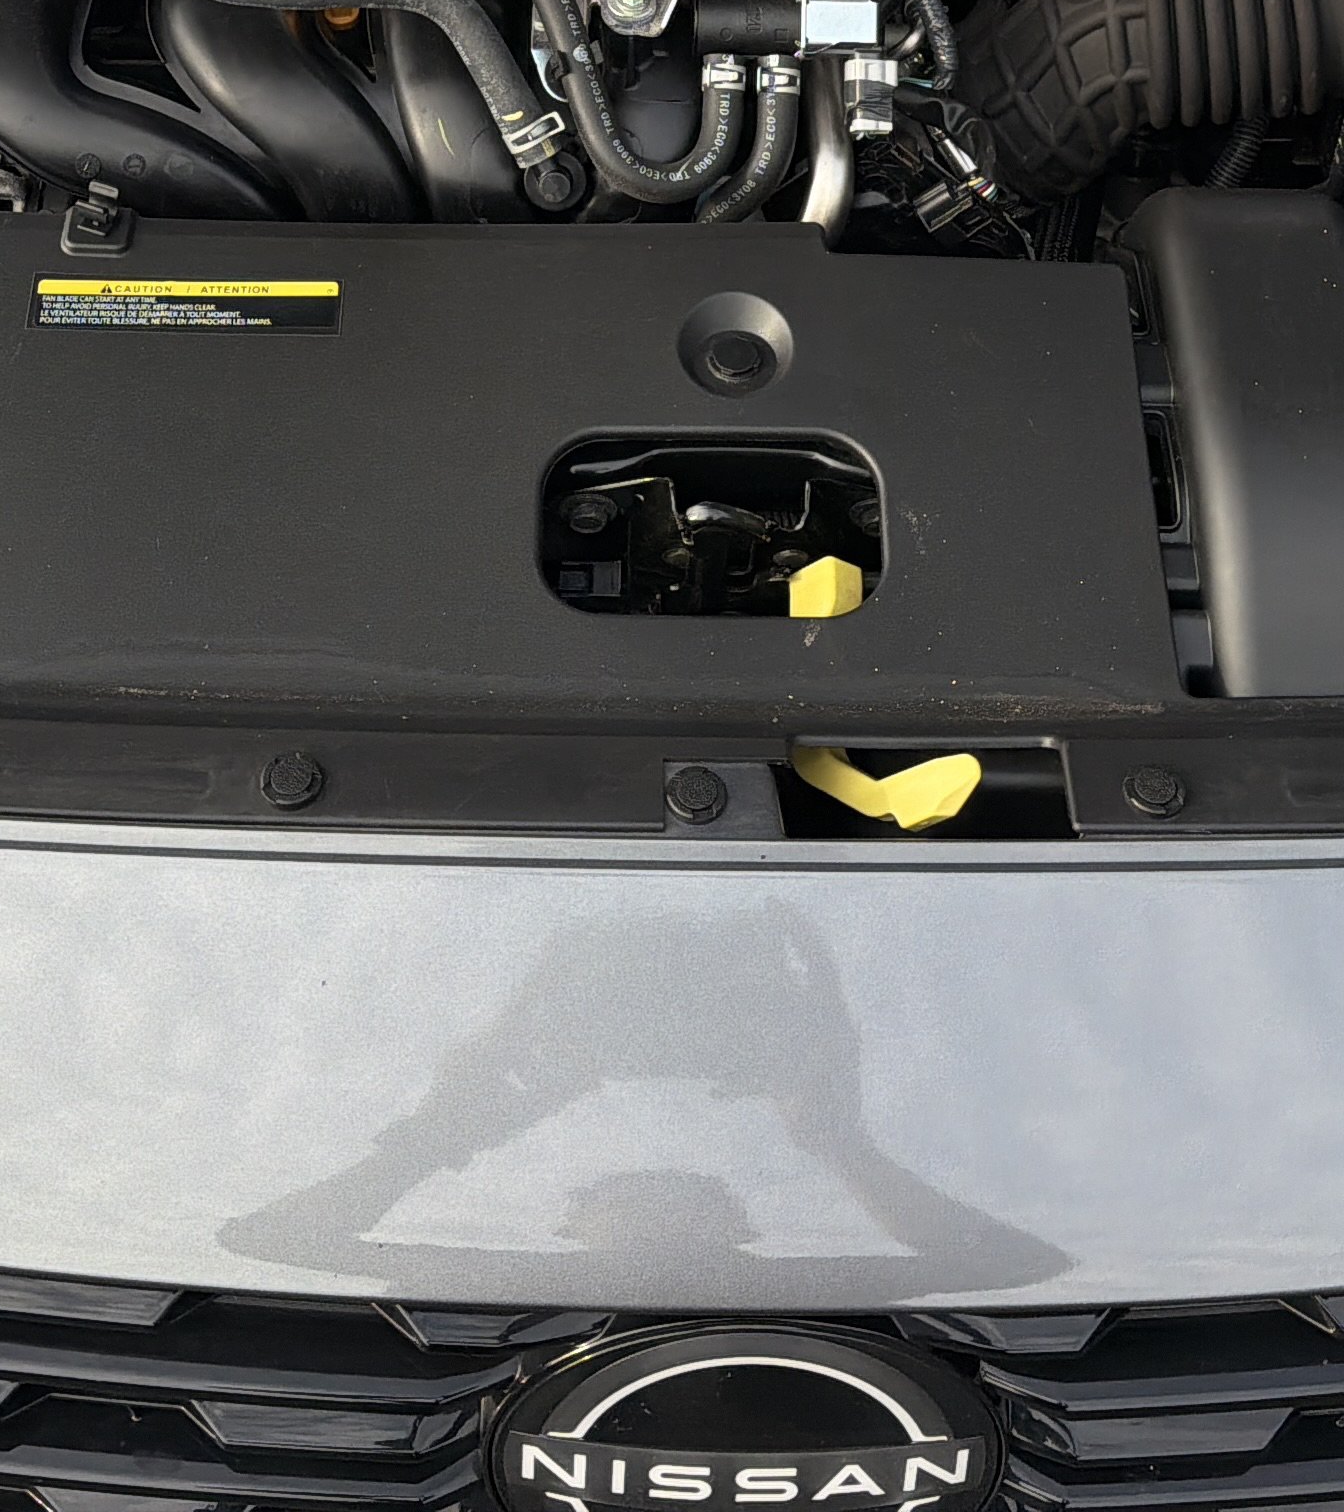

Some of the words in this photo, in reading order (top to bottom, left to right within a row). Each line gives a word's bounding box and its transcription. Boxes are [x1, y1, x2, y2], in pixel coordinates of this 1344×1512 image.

[693, 92, 731, 175] TRD>ECO<3909
[115, 285, 172, 294] CAUTION
[186, 285, 191, 294] /
[200, 285, 270, 294] ATTENTION
[40, 309, 49, 317] LE
[49, 309, 98, 317] VENTILATEUR
[40, 316, 60, 324] POUR
[87, 317, 111, 325] TOUTE
[188, 318, 232, 326] APPROCHER
[232, 318, 246, 326] LES
[521, 1443, 970, 1502] NISSAN
